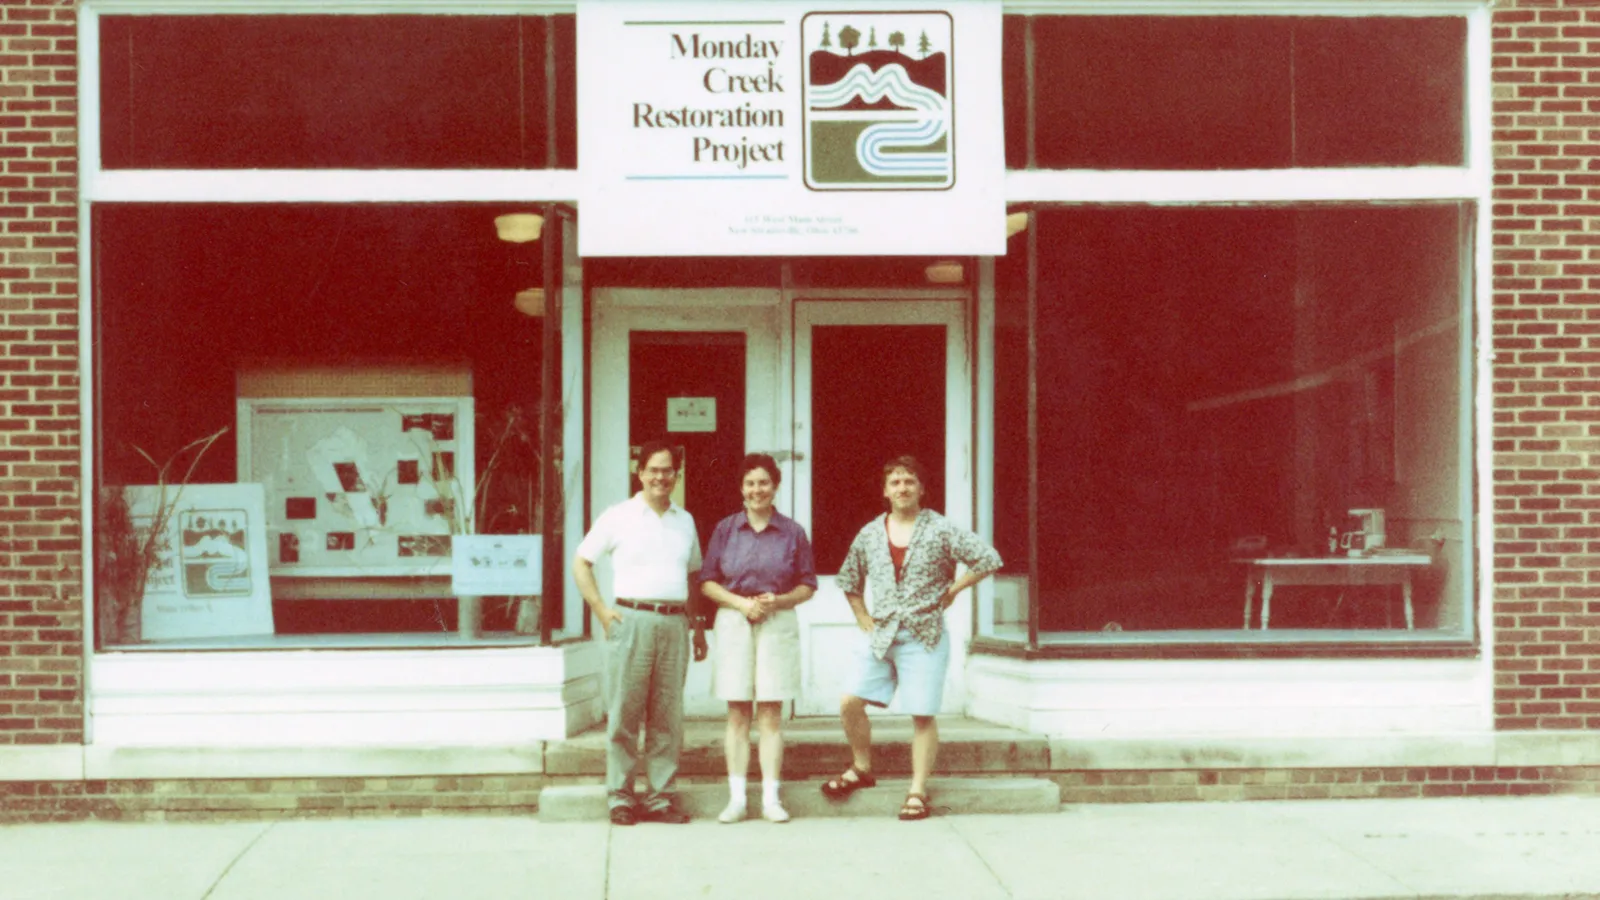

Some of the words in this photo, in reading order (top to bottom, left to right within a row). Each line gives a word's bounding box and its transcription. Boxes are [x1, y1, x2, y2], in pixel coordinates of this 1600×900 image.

[671, 33, 784, 66] Monday
[703, 67, 784, 93] Creek
[633, 102, 784, 128] Restoration
[693, 136, 784, 169] Project
